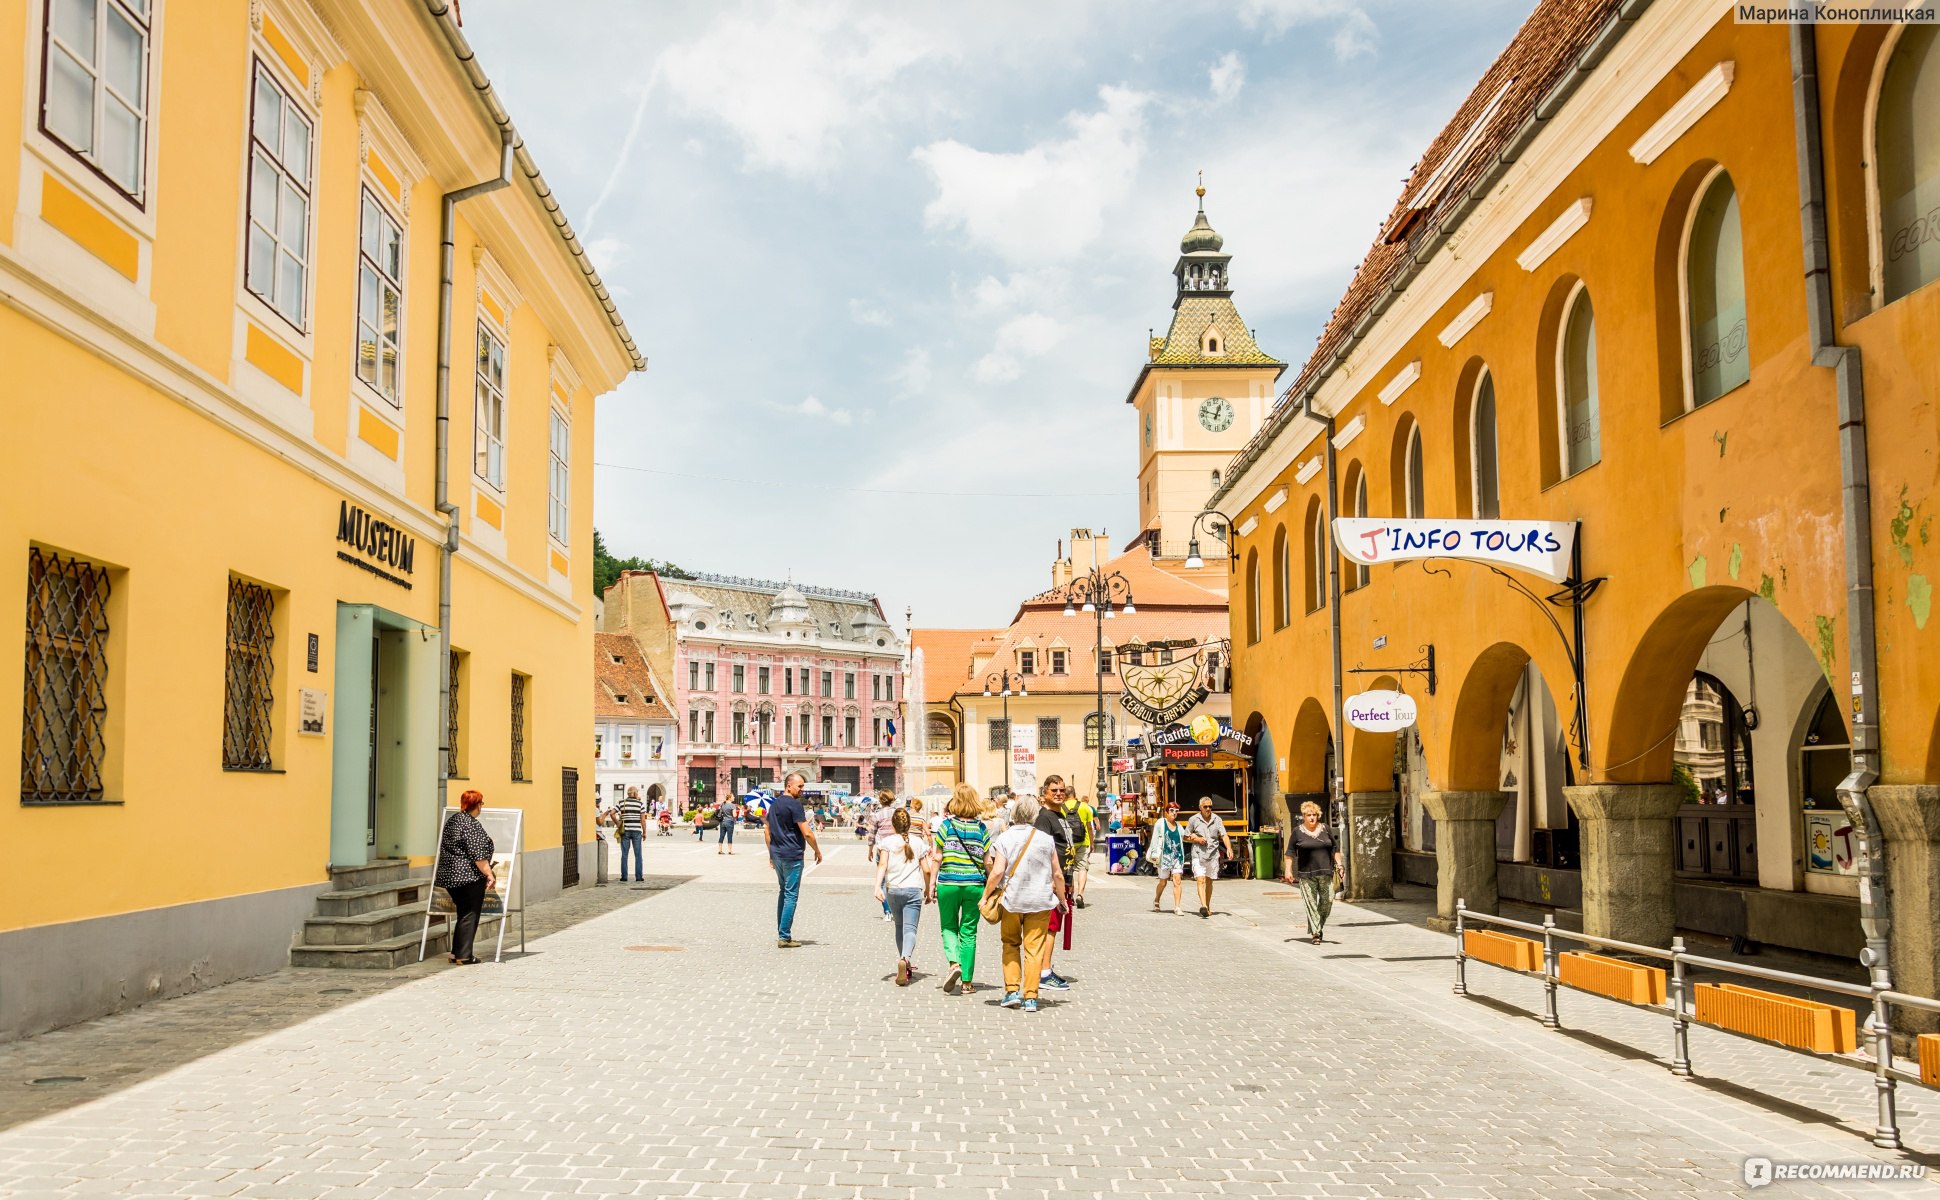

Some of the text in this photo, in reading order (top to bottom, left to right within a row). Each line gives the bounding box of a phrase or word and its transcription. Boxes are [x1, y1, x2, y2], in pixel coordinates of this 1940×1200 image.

[336, 500, 415, 574] MUSEUM
[1360, 527, 1561, 560] J'INFO TOURS
[1351, 707, 1415, 721] Perfect Tour
[1219, 726, 1253, 746] Uriasa
[1164, 747, 1208, 759] Papanasi
